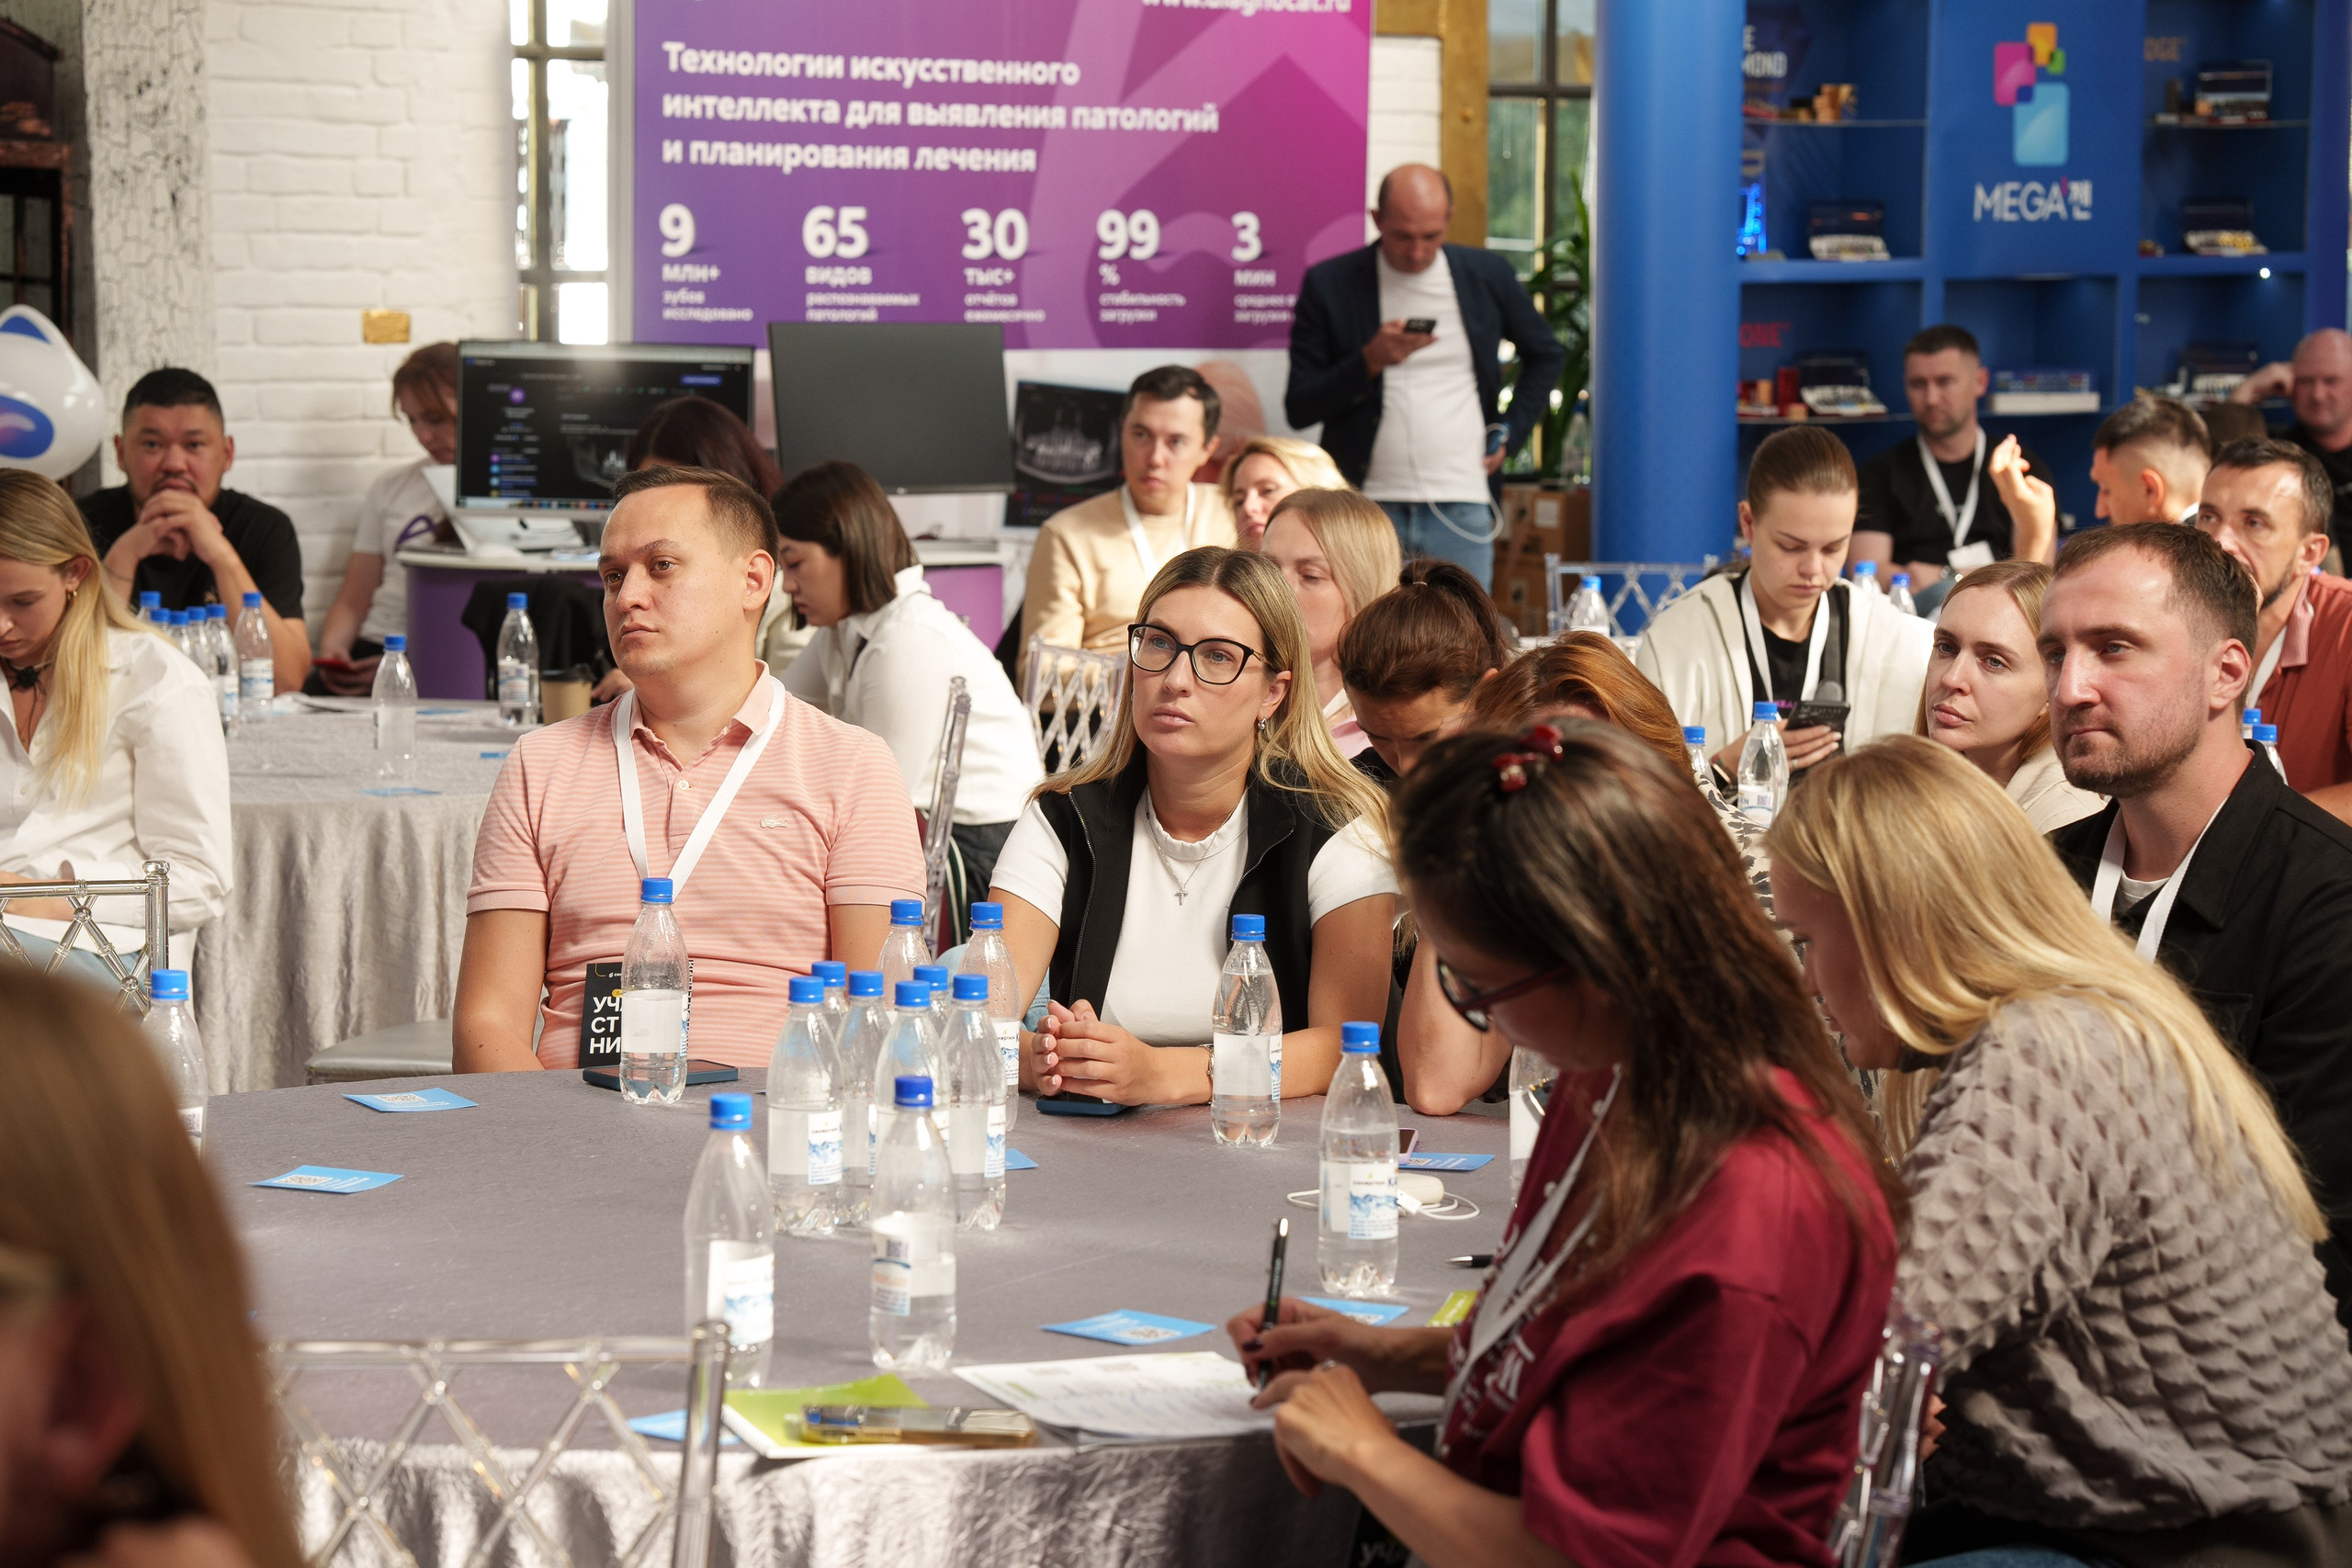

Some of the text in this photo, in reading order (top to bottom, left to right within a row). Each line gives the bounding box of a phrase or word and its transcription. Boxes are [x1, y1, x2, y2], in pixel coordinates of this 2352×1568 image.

[662, 41, 1081, 89] Технологии искусственного
[662, 93, 1220, 133] интеллекта для выявления патологий
[662, 139, 1036, 175] и планирования лечения
[659, 203, 695, 257] 9
[802, 205, 869, 259] 65
[961, 208, 1029, 261] 30
[1096, 209, 1160, 261] 99
[1231, 211, 1262, 263] 3
[1099, 263, 1120, 286] %
[1099, 289, 1186, 307] стабильность
[593, 996, 623, 1013] УЧ
[591, 1016, 620, 1034] СТ
[589, 1036, 621, 1055] НИ
